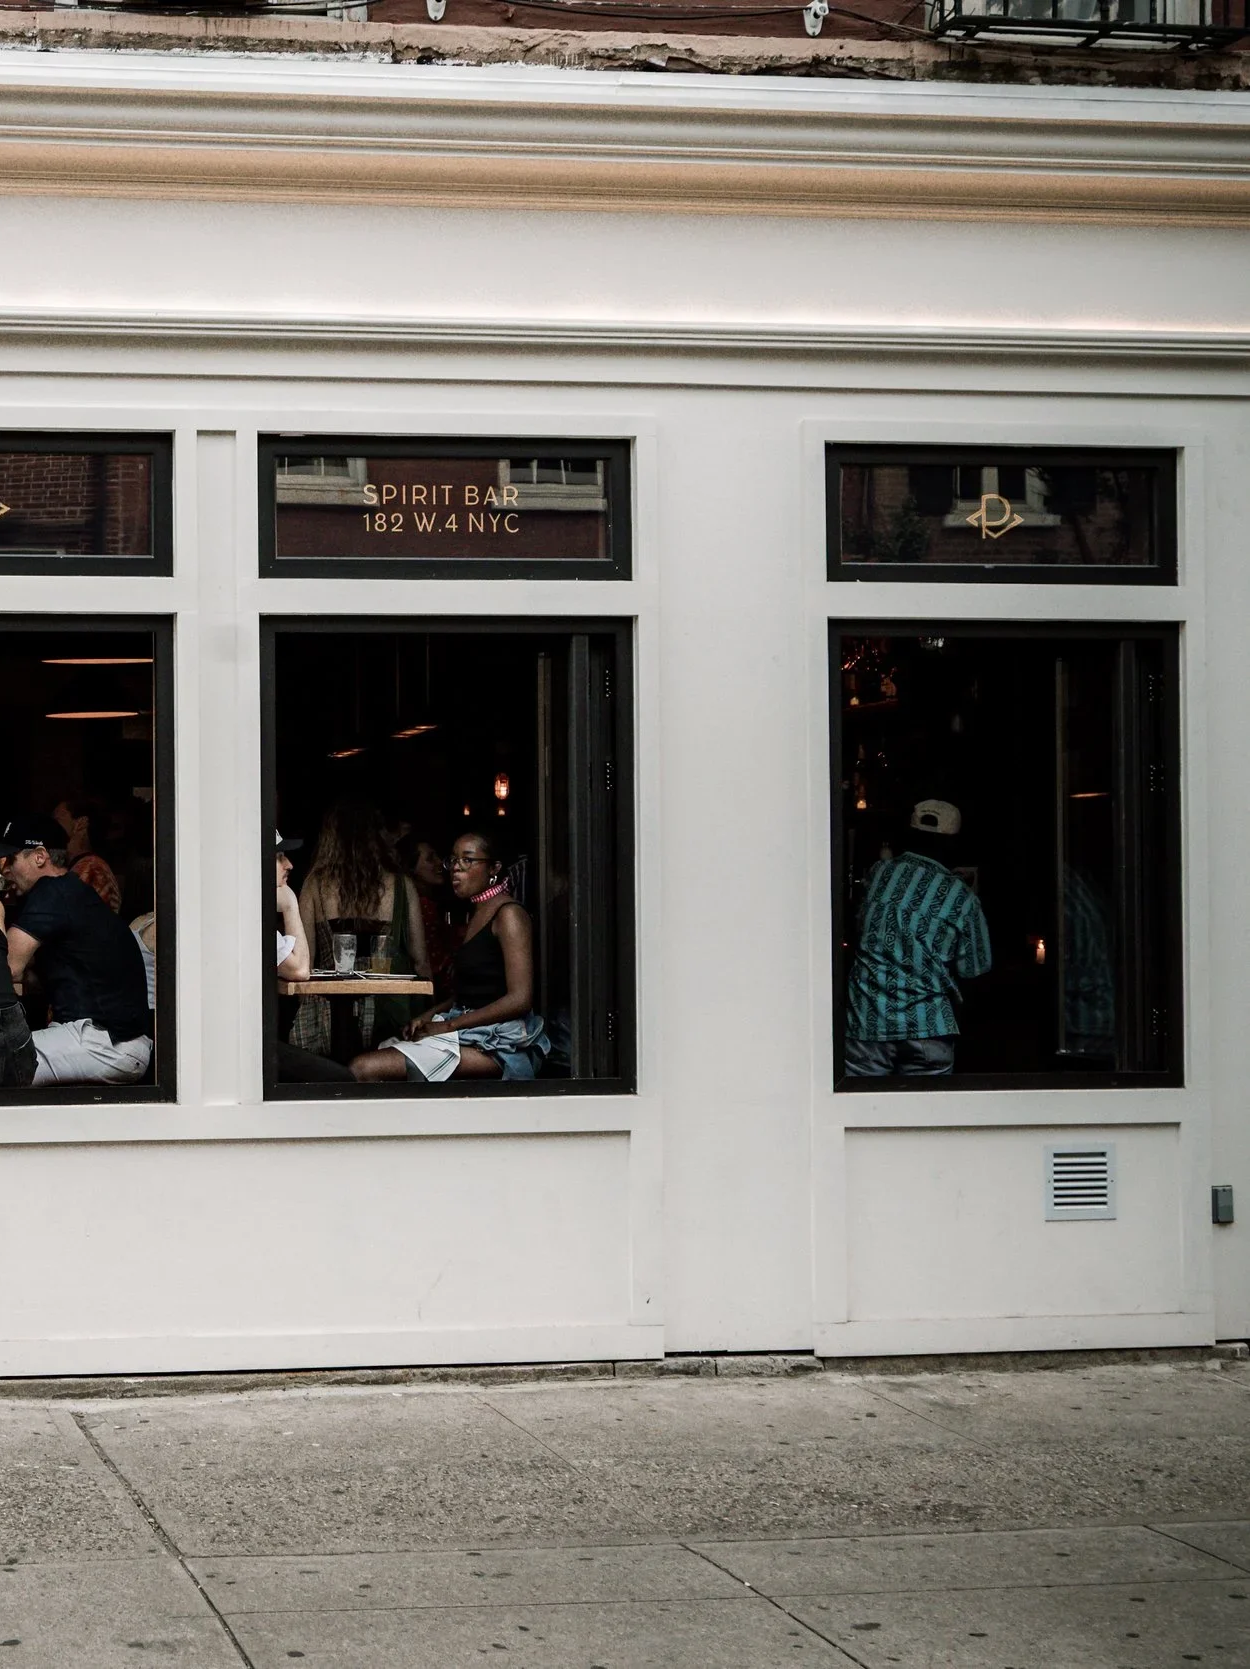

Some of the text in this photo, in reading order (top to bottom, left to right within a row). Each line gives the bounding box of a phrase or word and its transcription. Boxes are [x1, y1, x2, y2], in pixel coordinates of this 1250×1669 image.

[363, 484, 519, 506] SPIRIT BAR
[363, 512, 520, 533] 182 W.4 NYC
